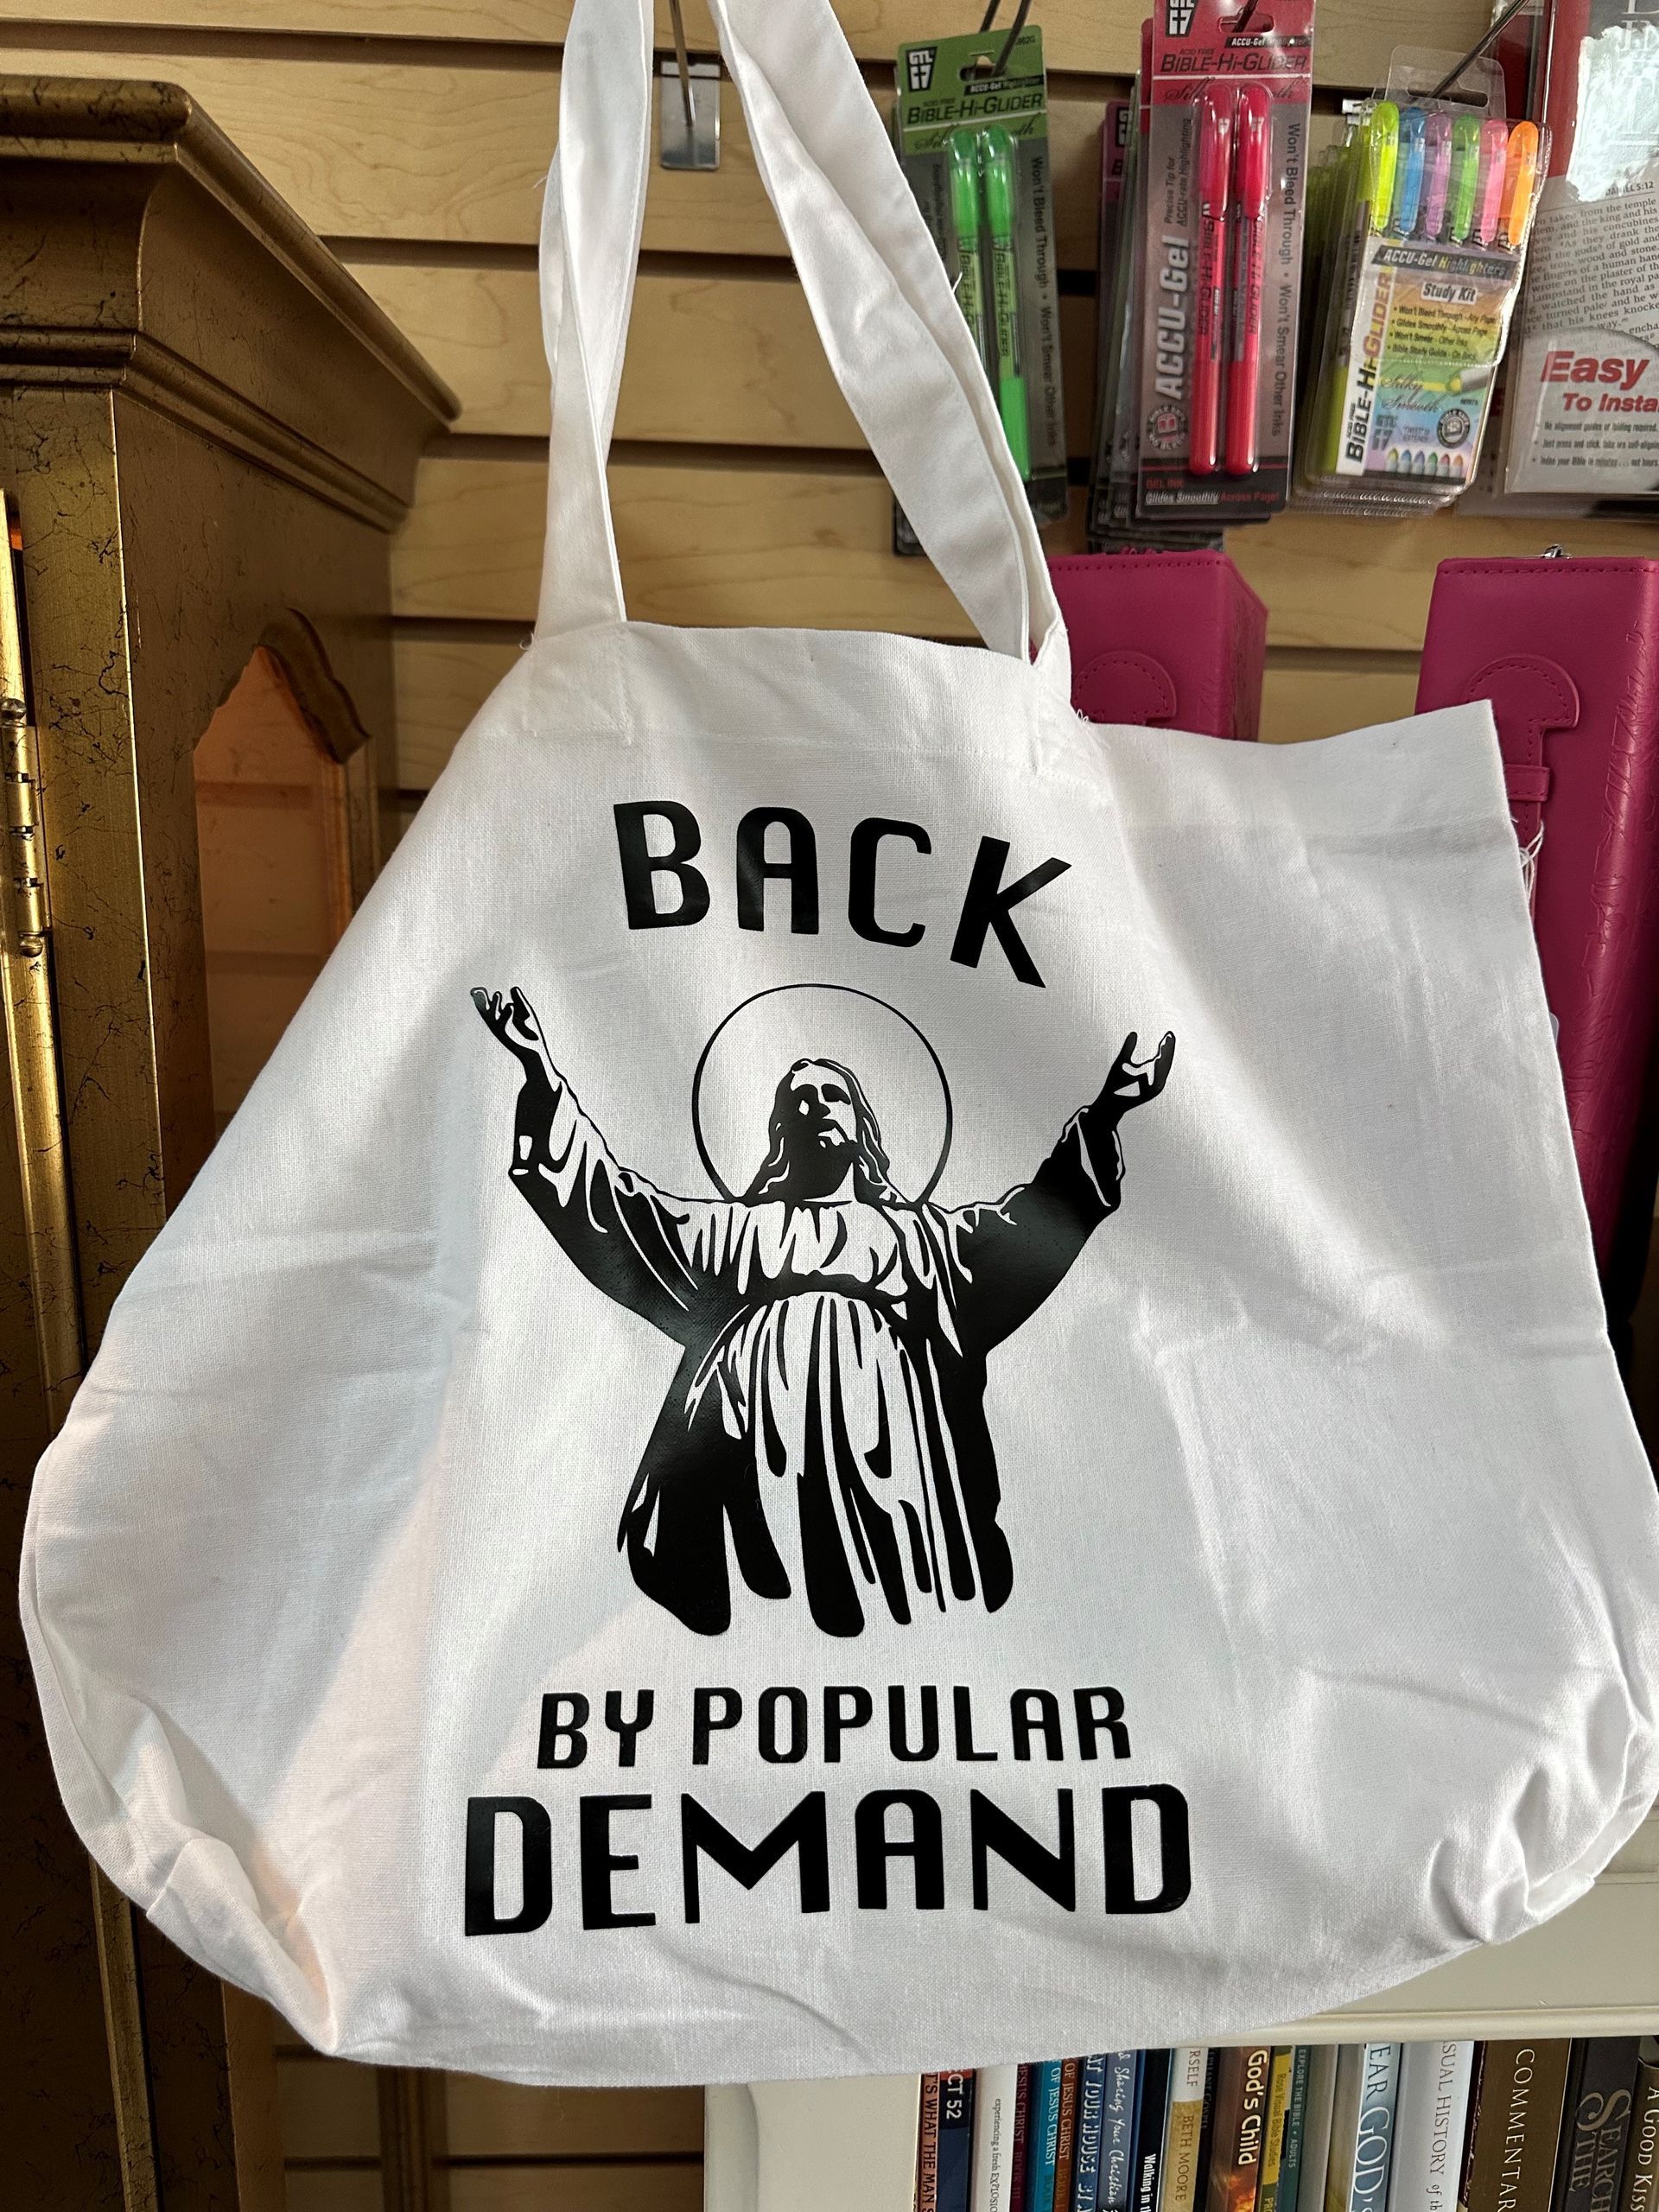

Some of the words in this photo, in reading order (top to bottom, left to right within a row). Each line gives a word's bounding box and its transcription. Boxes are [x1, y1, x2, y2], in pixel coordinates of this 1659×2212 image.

[1231, 37, 1265, 46] ACCU-Gel
[1287, 123, 1300, 165] Won't
[1167, 157, 1176, 169] for
[1166, 172, 1176, 187] Tip
[1285, 168, 1298, 205] Bleed
[1637, 181, 1654, 191] 5:12
[1580, 207, 1603, 218] from
[1606, 204, 1622, 213] the
[1624, 198, 1656, 212] temple
[1599, 213, 1621, 225] king
[1623, 208, 1641, 219] and
[1643, 207, 1658, 216] his
[1279, 208, 1296, 266] Through
[1603, 216, 1659, 232] concubines
[1610, 229, 1639, 241] drank
[1644, 225, 1659, 234] the
[1383, 248, 1438, 267] ACCU-Gel
[1609, 250, 1627, 260] and
[1618, 238, 1640, 251] gold
[1580, 273, 1599, 283] the
[1600, 266, 1634, 282] plaster
[1636, 263, 1647, 273] of
[1601, 258, 1637, 271] human
[1422, 283, 1456, 302] Study
[1458, 287, 1476, 302] Kit
[1591, 291, 1607, 302] the
[1613, 285, 1640, 298] hand
[1644, 283, 1656, 292] as
[1601, 278, 1618, 289] the
[1620, 274, 1646, 287] royal
[1278, 285, 1293, 323] Won't
[1611, 296, 1630, 308] and
[1633, 293, 1647, 303] he
[1154, 234, 1190, 401] ACCU-Gel
[1589, 309, 1620, 322] knees
[1274, 327, 1289, 368] Smear
[1540, 351, 1650, 391] Easy
[1273, 372, 1287, 406] Other
[1563, 392, 1592, 412] To
[1599, 393, 1659, 413] Insta
[1272, 410, 1286, 436] Inks
[613, 800, 1072, 988] BACK
[537, 1689, 654, 1770] BY
[692, 1685, 1131, 1765] POPULAR
[464, 1783, 1192, 1937] DEMAND
[1051, 2067, 1061, 2083] OF
[1064, 2063, 1076, 2078] OF
[1186, 2050, 1202, 2087] RSELF
[1243, 2049, 1268, 2110] God's
[1295, 2048, 1306, 2084] EXPLORE
[1365, 2044, 1391, 2101] EAR
[1438, 2043, 1457, 2092] SUAL
[946, 2073, 963, 2094] CT
[1109, 2066, 1130, 2113] Sharing
[1276, 2073, 1287, 2094] Rose
[1294, 2087, 1304, 2101] THE
[1647, 2086, 1659, 2101] A
[945, 2100, 963, 2119] 52
[1048, 2088, 1060, 2122] JESUS
[1062, 2083, 1074, 2116] JESUS
[924, 2100, 938, 2138] WHAT
[991, 2098, 1001, 2146] experiencing
[1013, 2102, 1027, 2144] CHRIST
[1270, 2119, 1282, 2138] Bible
[1292, 2103, 1302, 2126] BIBLE
[1046, 2124, 1058, 2165] CHRIST
[1059, 2119, 1072, 2159] CHRIST
[1108, 2118, 1126, 2145] Your
[1179, 2114, 1194, 2148] BETH
[1237, 2114, 1262, 2166] Child
[1429, 2094, 1452, 2176] HISTORY
[1497, 2048, 1535, 2212] COMMENTAR
[1637, 2109, 1659, 2165] GOOD
[923, 2143, 936, 2169] THE
[991, 2152, 1001, 2171] fresh
[1268, 2139, 1281, 2167] Studies
[1288, 2139, 1300, 2168] ADULTS
[1569, 2132, 1598, 2192] THE
[1575, 2088, 1632, 2212] SEARCH
[1107, 2150, 1124, 2205] Christian
[1140, 2153, 1156, 2192] Walking
[1174, 2152, 1189, 2202] MOORE
[921, 2174, 936, 2203] MAN
[1141, 2193, 1153, 2203] in
[1426, 2184, 1443, 2196] of
